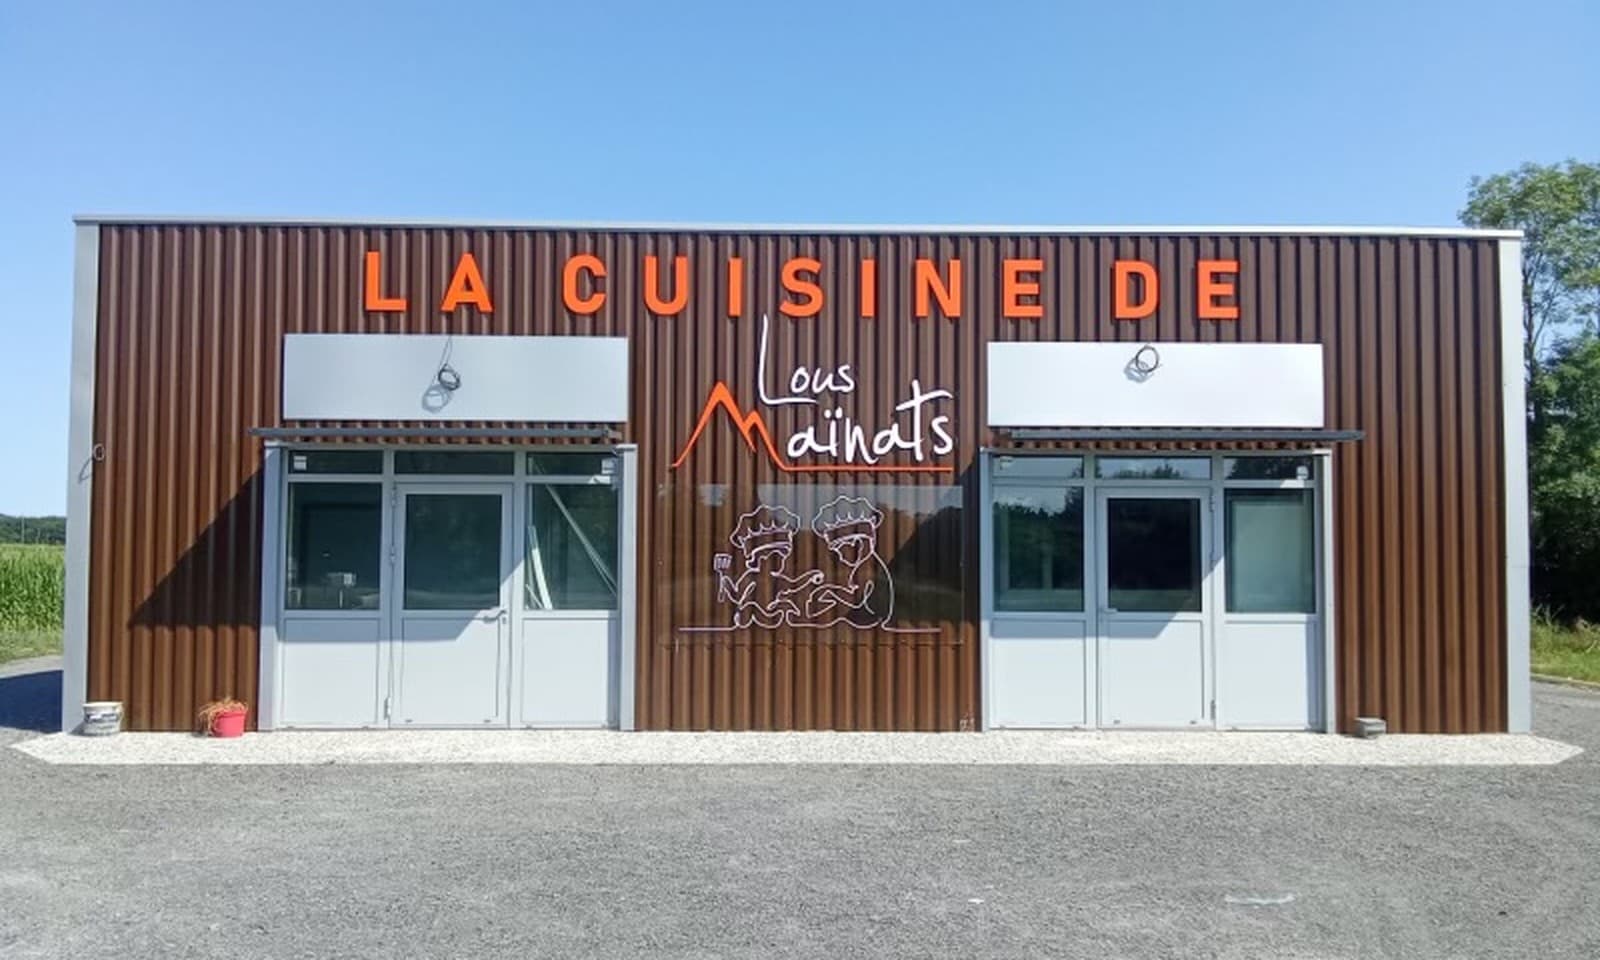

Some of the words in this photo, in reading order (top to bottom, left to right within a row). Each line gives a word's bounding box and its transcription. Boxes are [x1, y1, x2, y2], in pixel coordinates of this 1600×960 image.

[364, 251, 493, 312] LA
[563, 253, 1045, 319] CUISINE
[1114, 260, 1240, 320] DE
[758, 313, 855, 405] Lous
[672, 379, 954, 470] Maïnats
